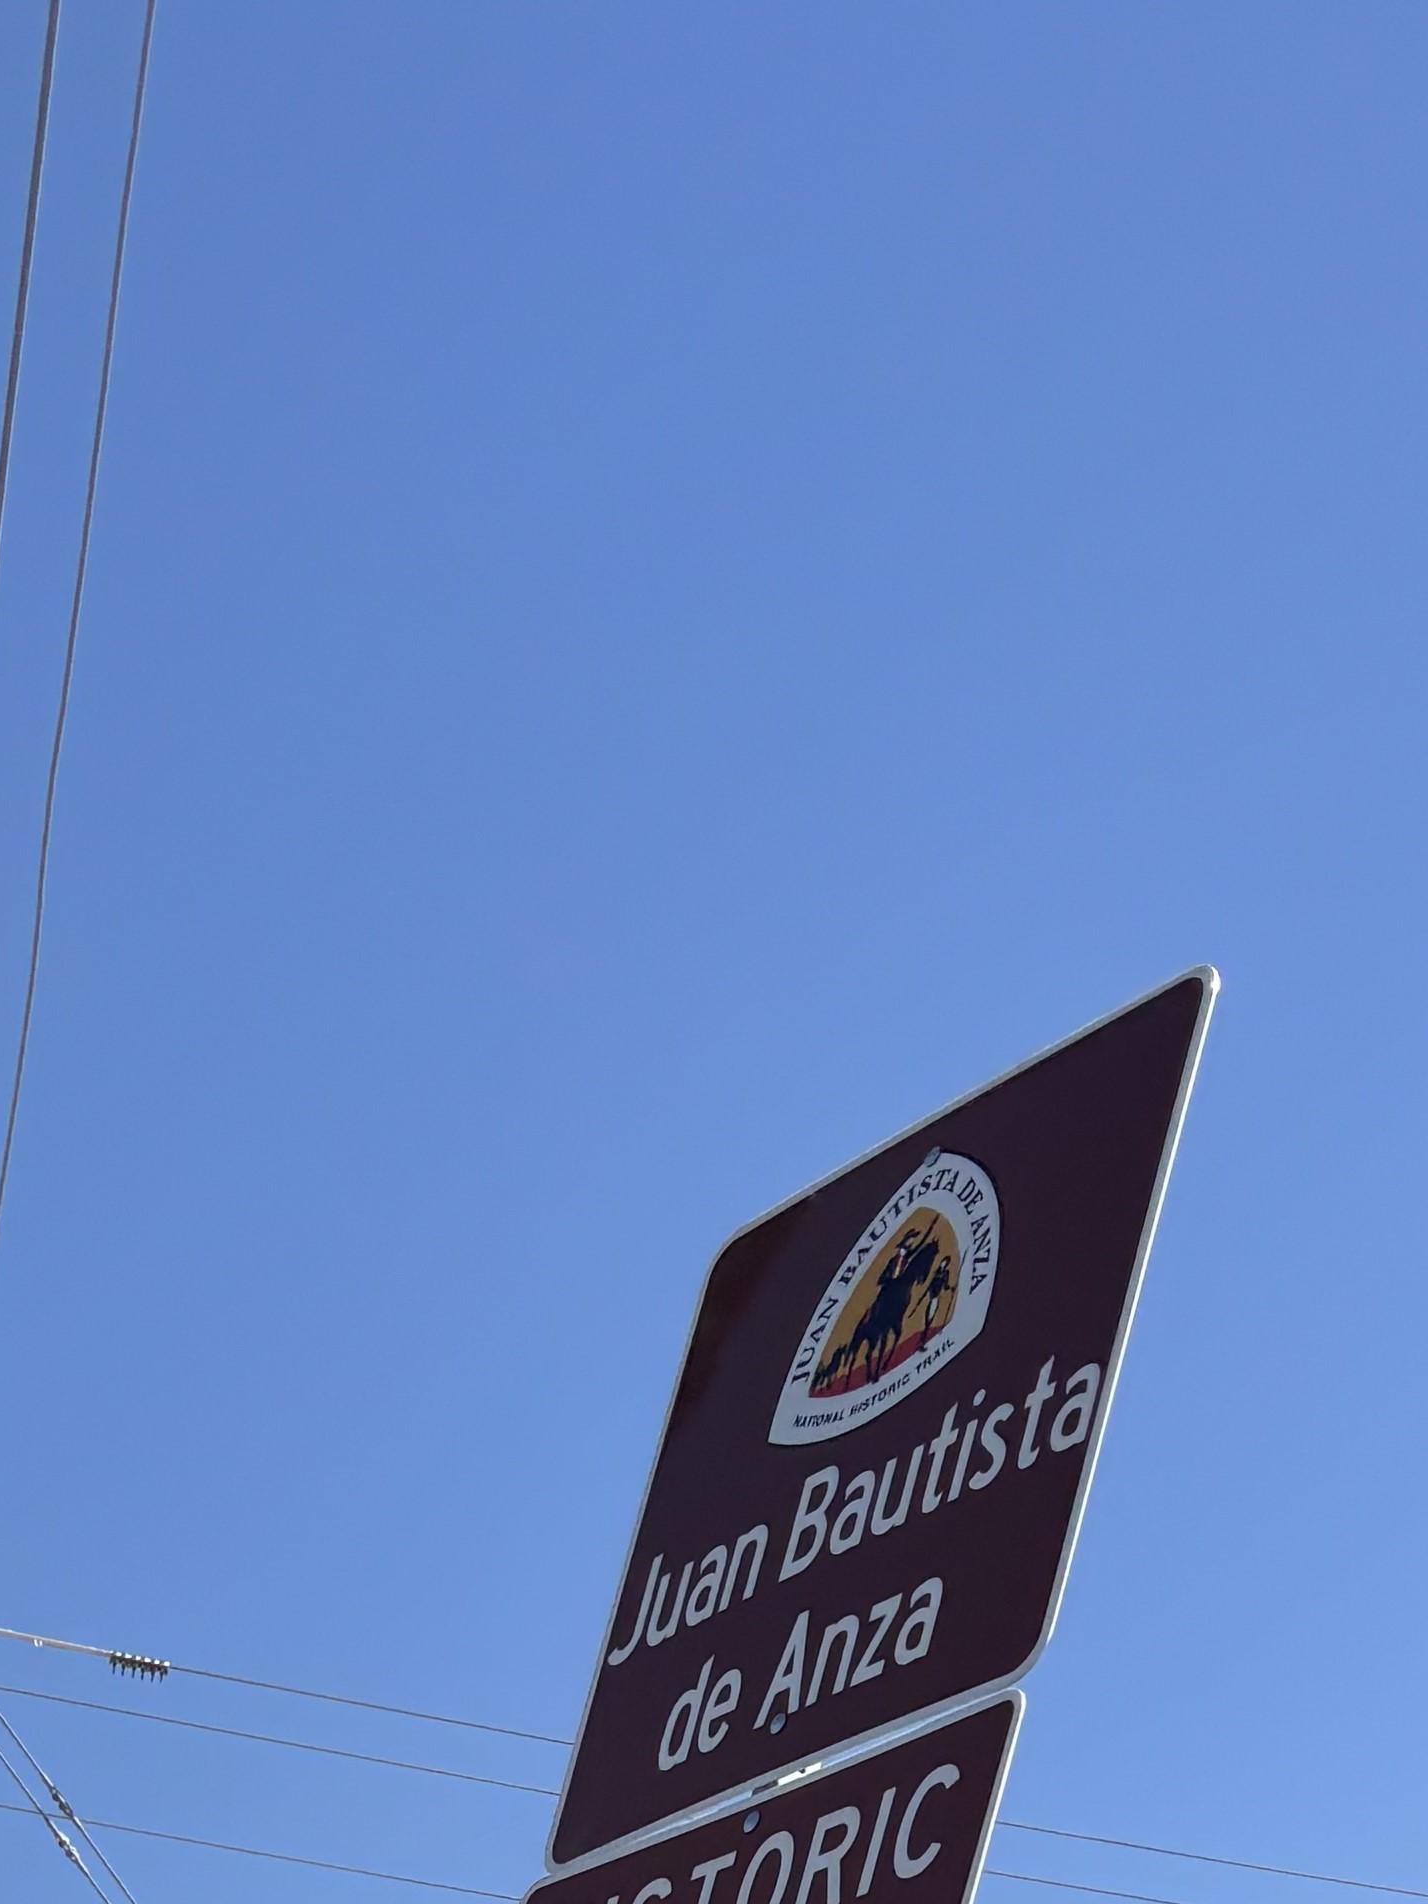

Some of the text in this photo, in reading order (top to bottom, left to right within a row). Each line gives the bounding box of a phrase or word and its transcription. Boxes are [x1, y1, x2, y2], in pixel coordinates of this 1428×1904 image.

[790, 1168, 994, 1385] JUAN BAUTISTA DE ANZA
[792, 1338, 956, 1429] NATIONAL HISTORIC TRAIL
[607, 1354, 1102, 1667] Juan Bautista
[658, 1577, 943, 1771] de Anza
